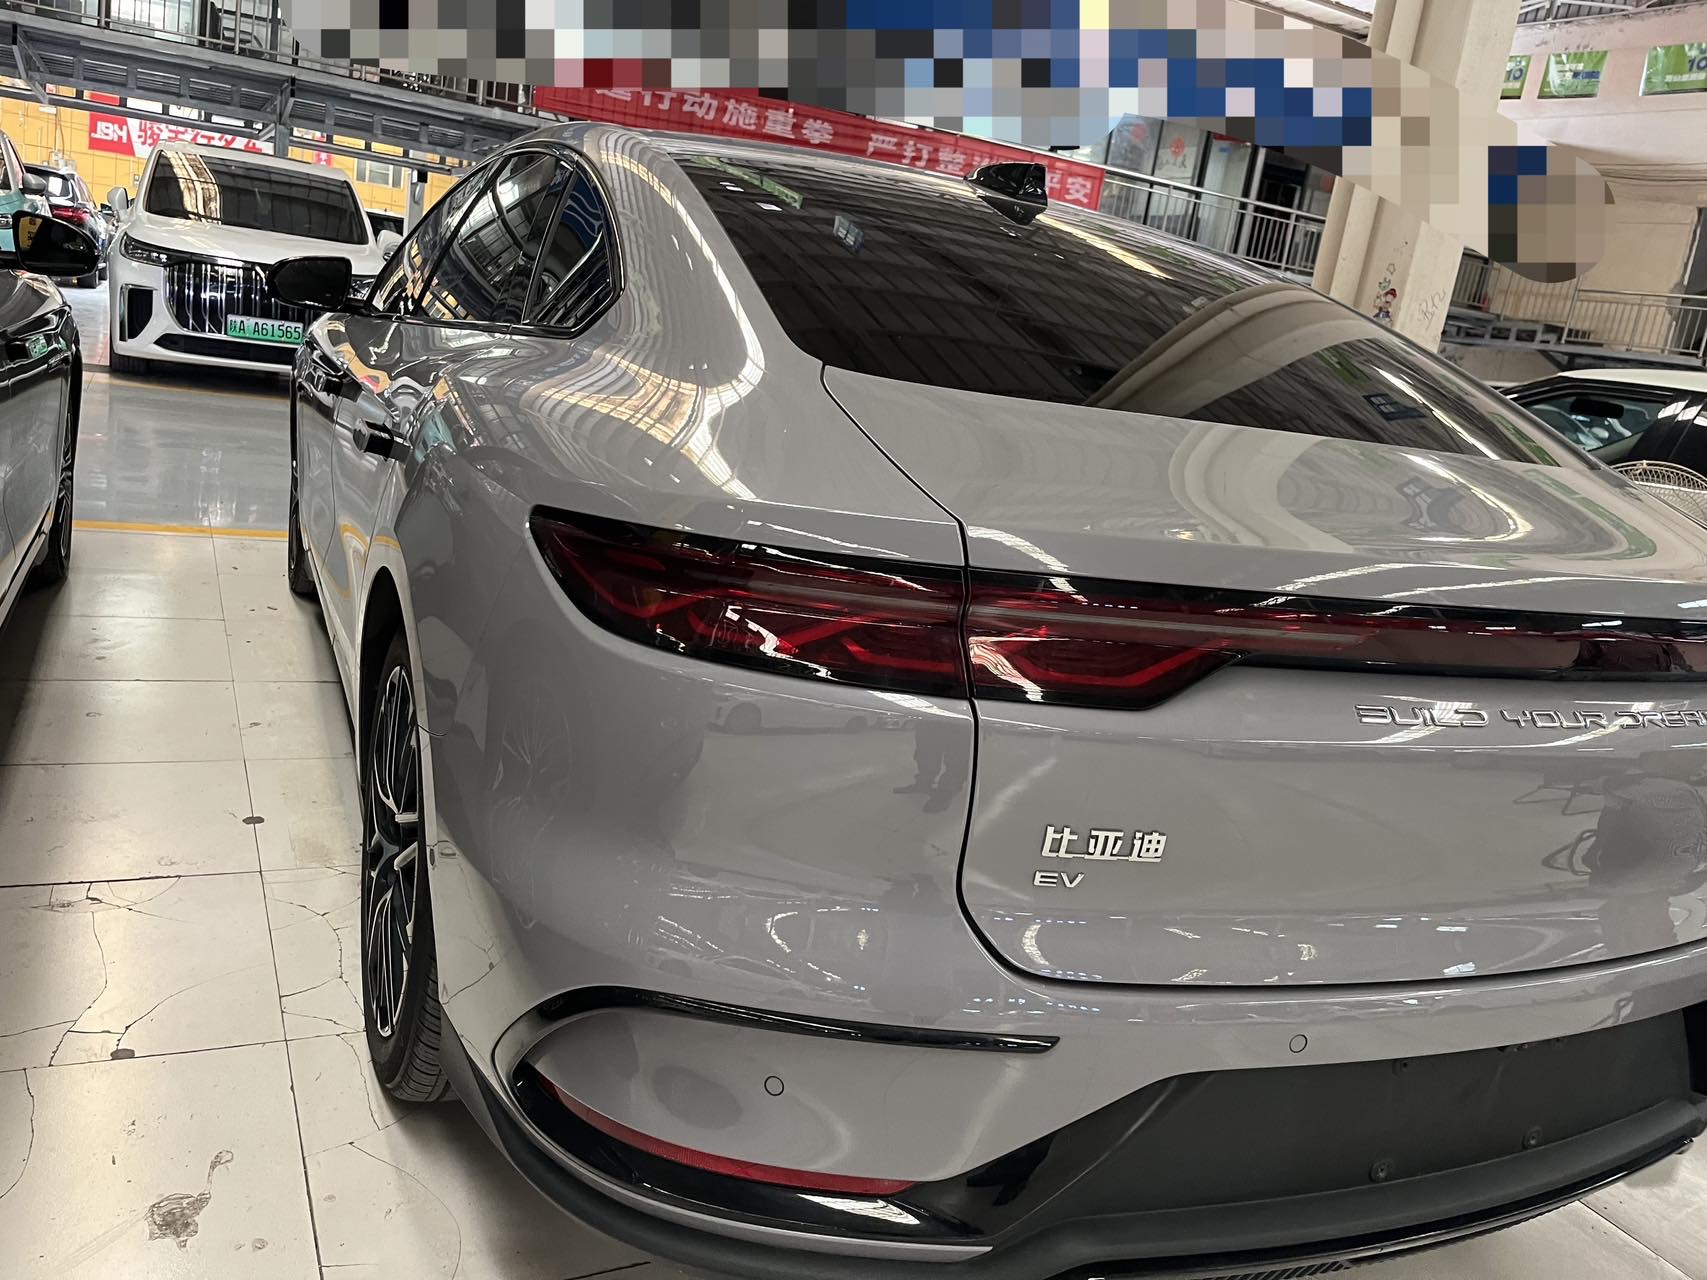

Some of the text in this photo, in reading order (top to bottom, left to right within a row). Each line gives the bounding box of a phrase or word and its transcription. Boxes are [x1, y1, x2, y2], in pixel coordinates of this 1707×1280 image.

[253, 321, 301, 340] A61565
[1354, 704, 1489, 728] BUILD
[1499, 707, 1609, 729] YOUR
[1041, 825, 1167, 863] 比亚迪
[1033, 870, 1085, 888] EV
